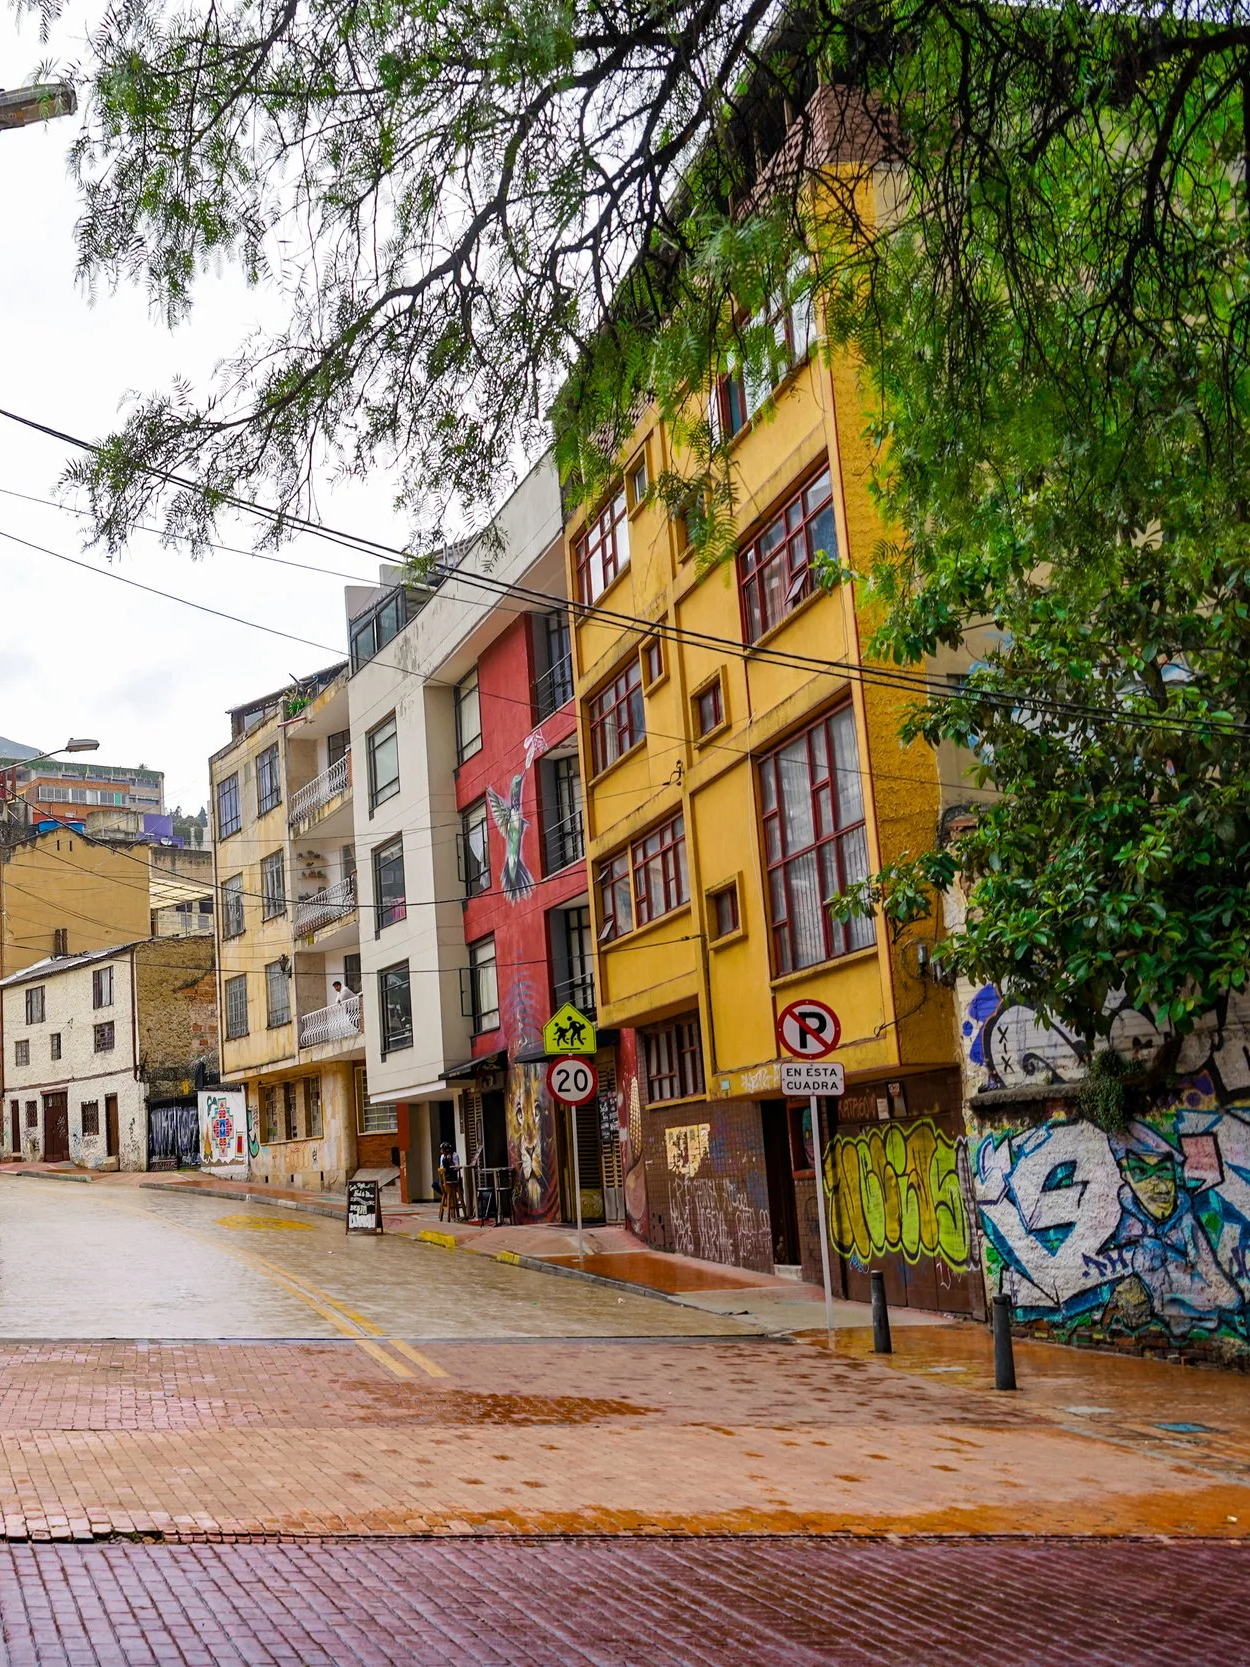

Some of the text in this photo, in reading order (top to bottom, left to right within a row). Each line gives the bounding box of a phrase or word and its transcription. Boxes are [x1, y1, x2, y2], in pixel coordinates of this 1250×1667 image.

[786, 1067, 802, 1077] EN
[556, 1068, 589, 1093] 20
[786, 1081, 839, 1090] CUADRA
